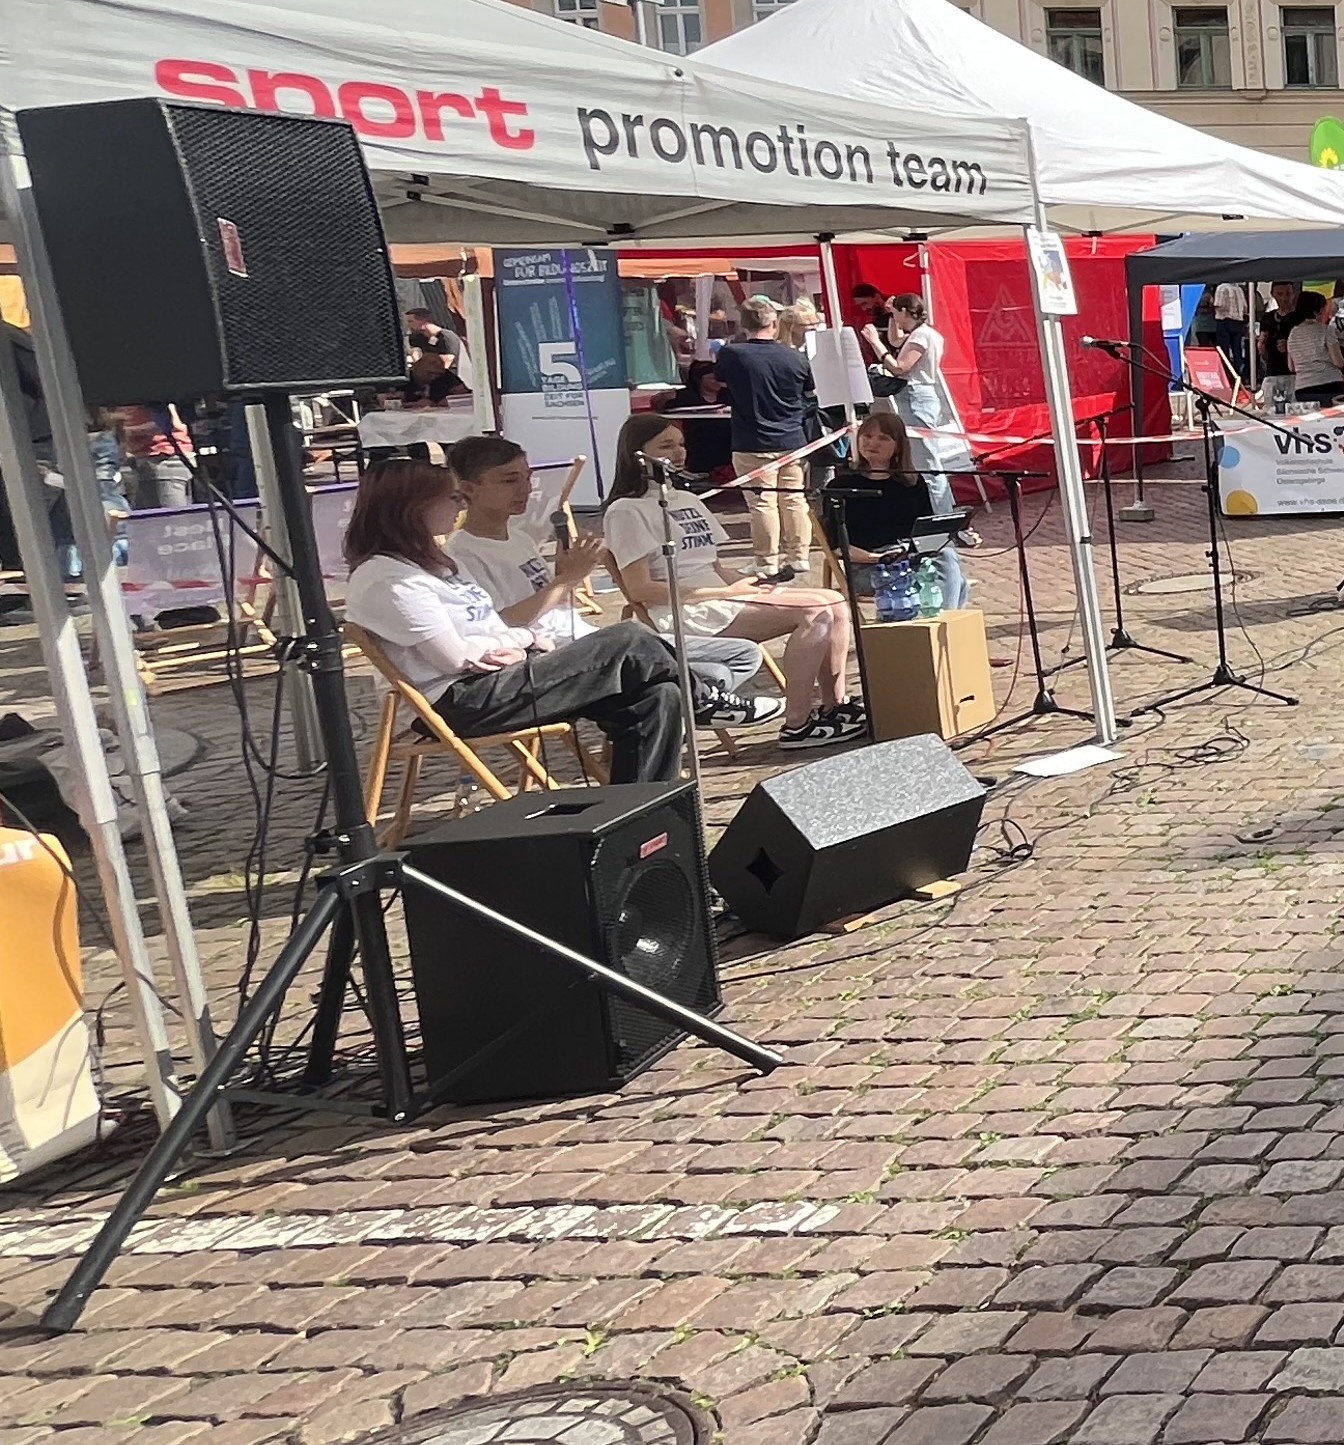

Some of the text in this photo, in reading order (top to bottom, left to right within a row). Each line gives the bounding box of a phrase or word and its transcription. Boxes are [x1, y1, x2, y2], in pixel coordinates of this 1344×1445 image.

[577, 106, 873, 184] promotion
[886, 140, 988, 196] team
[538, 341, 583, 383] 5
[1274, 426, 1333, 454] vhs
